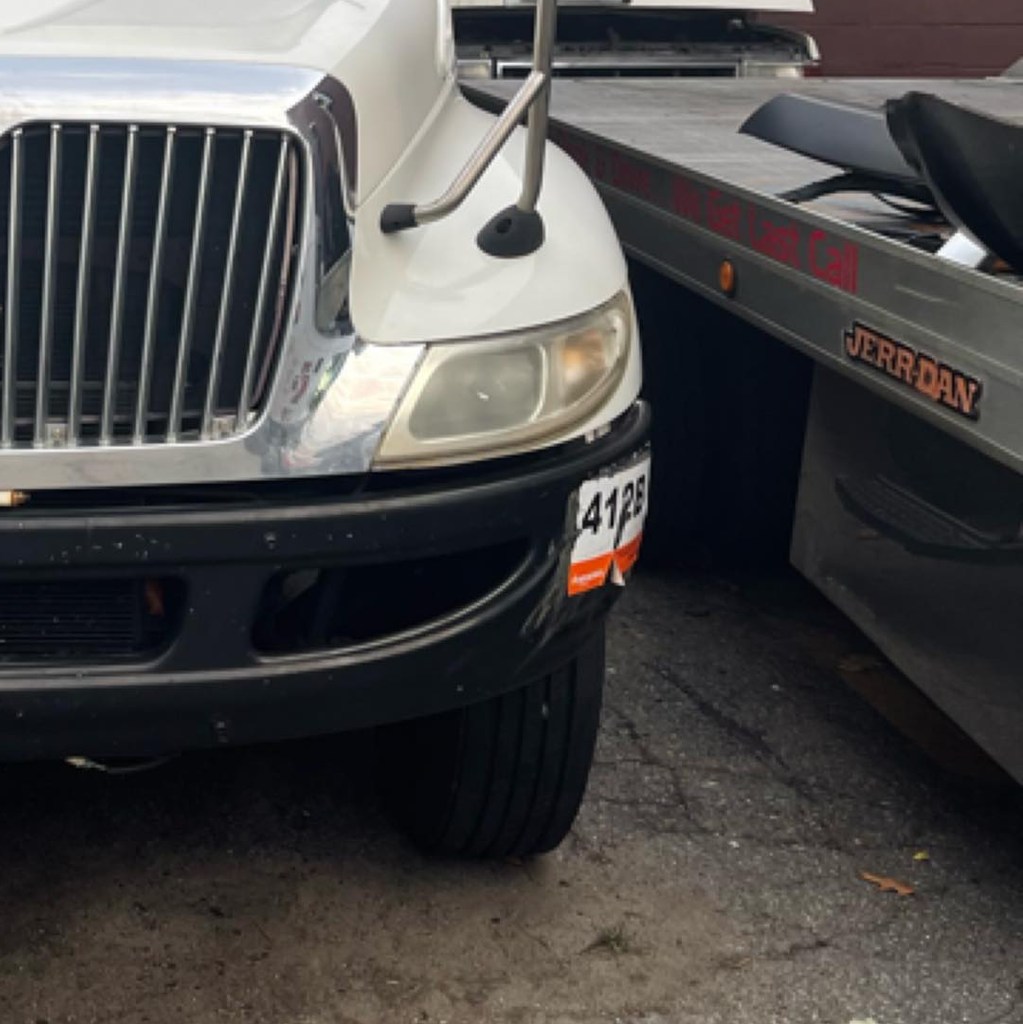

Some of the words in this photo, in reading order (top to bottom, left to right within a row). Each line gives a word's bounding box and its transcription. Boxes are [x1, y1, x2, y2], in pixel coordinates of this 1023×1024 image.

[747, 199, 802, 270] Last
[808, 229, 860, 295] Call
[844, 324, 979, 415] JERR-DAN
